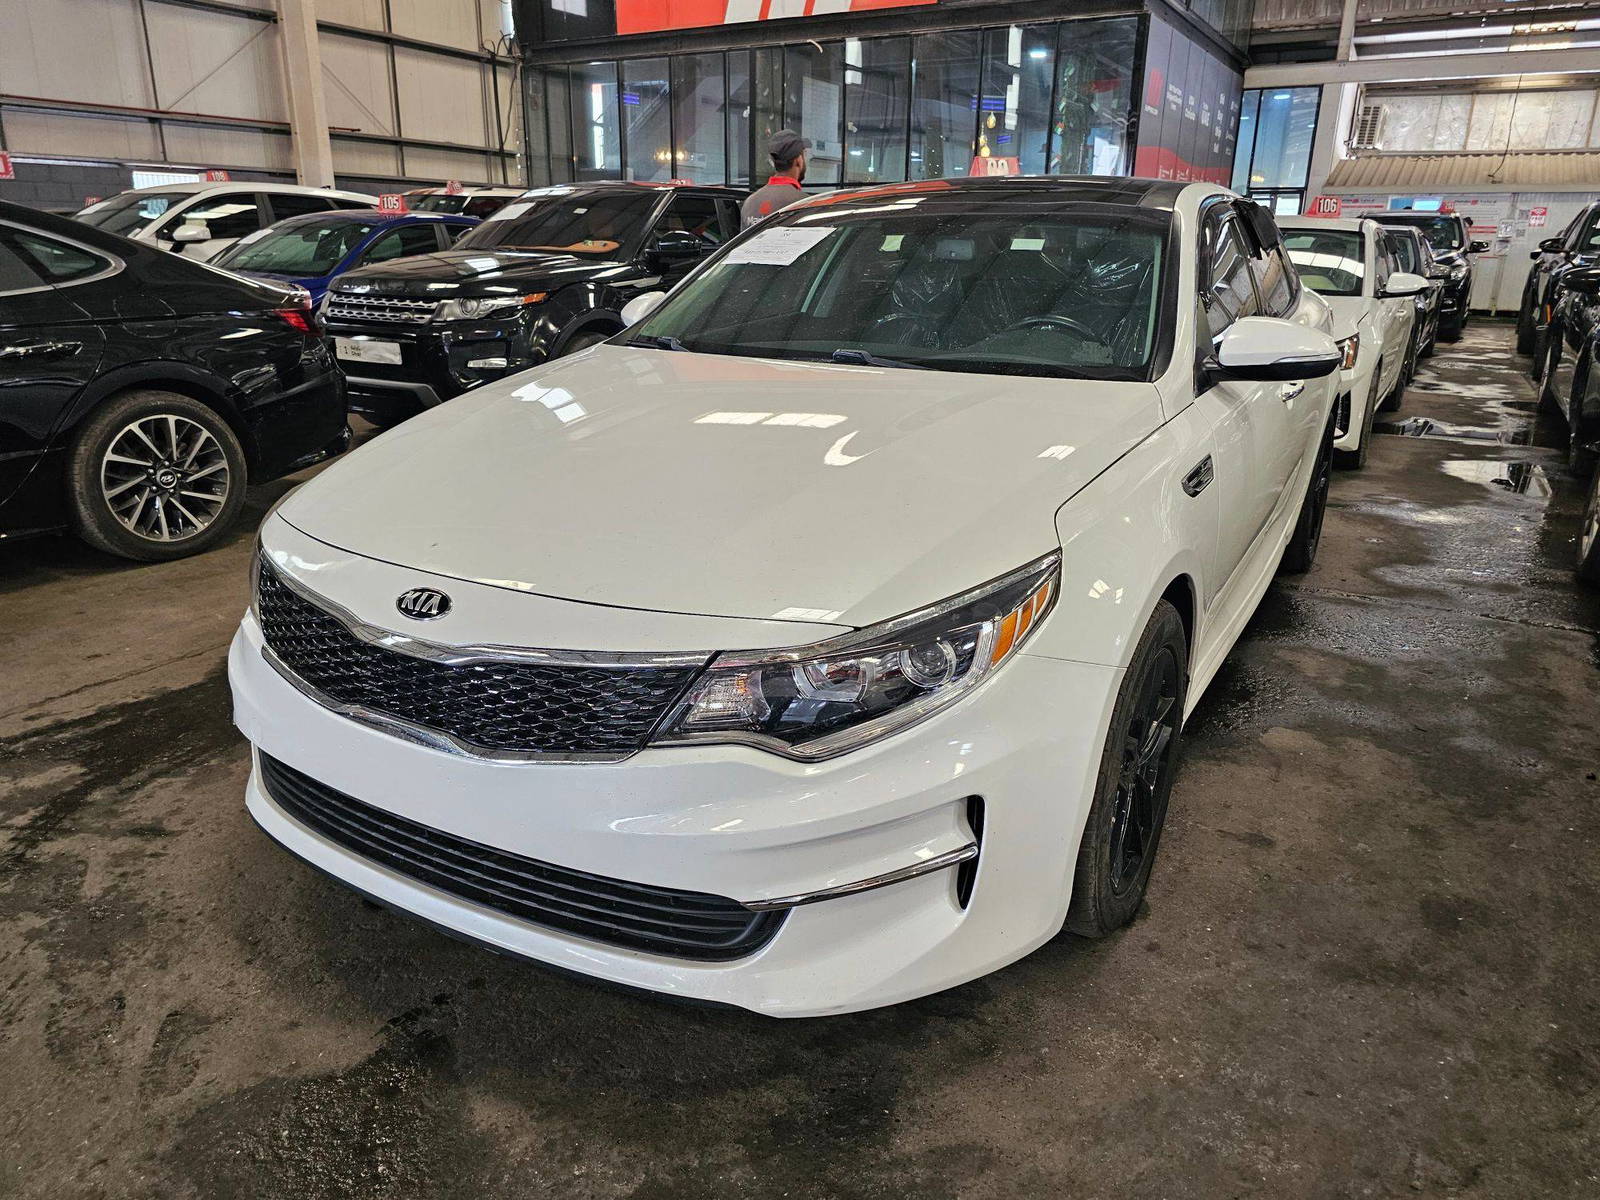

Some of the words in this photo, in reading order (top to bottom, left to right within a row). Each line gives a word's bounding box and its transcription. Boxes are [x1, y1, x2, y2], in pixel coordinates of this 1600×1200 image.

[382, 196, 399, 209] 105
[1319, 198, 1338, 213] 106
[400, 590, 443, 616] KIA
